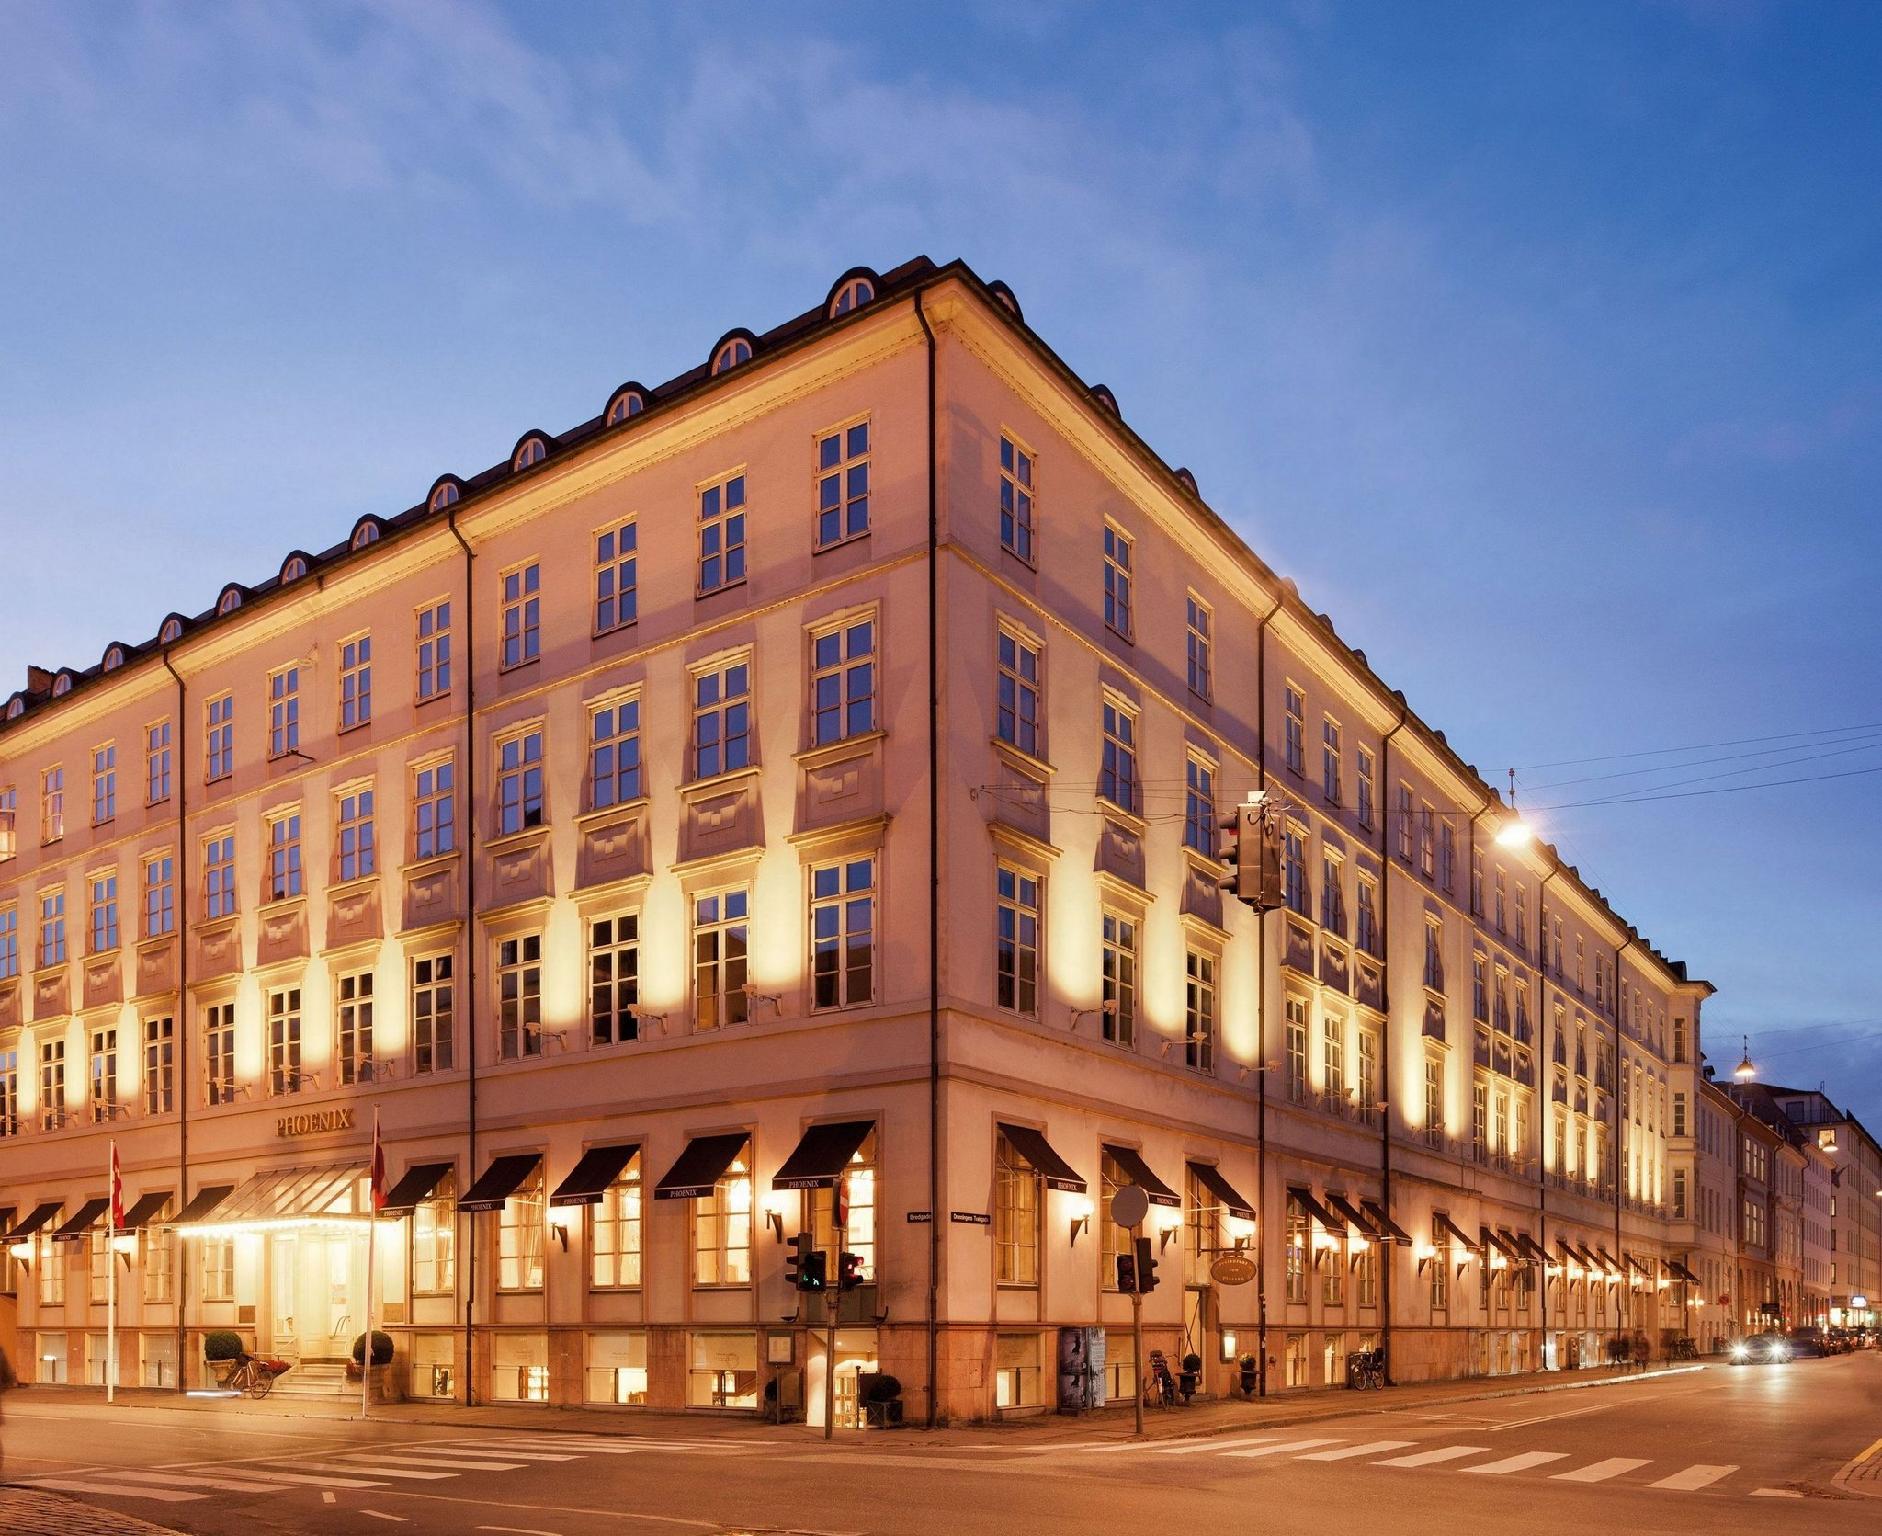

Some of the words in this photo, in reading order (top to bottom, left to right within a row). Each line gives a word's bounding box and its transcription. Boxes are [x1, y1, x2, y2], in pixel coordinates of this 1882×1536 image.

[276, 1108, 353, 1136] PHOENIX
[789, 1180, 819, 1189] PHOENIX
[670, 1189, 697, 1198] PHOENIX
